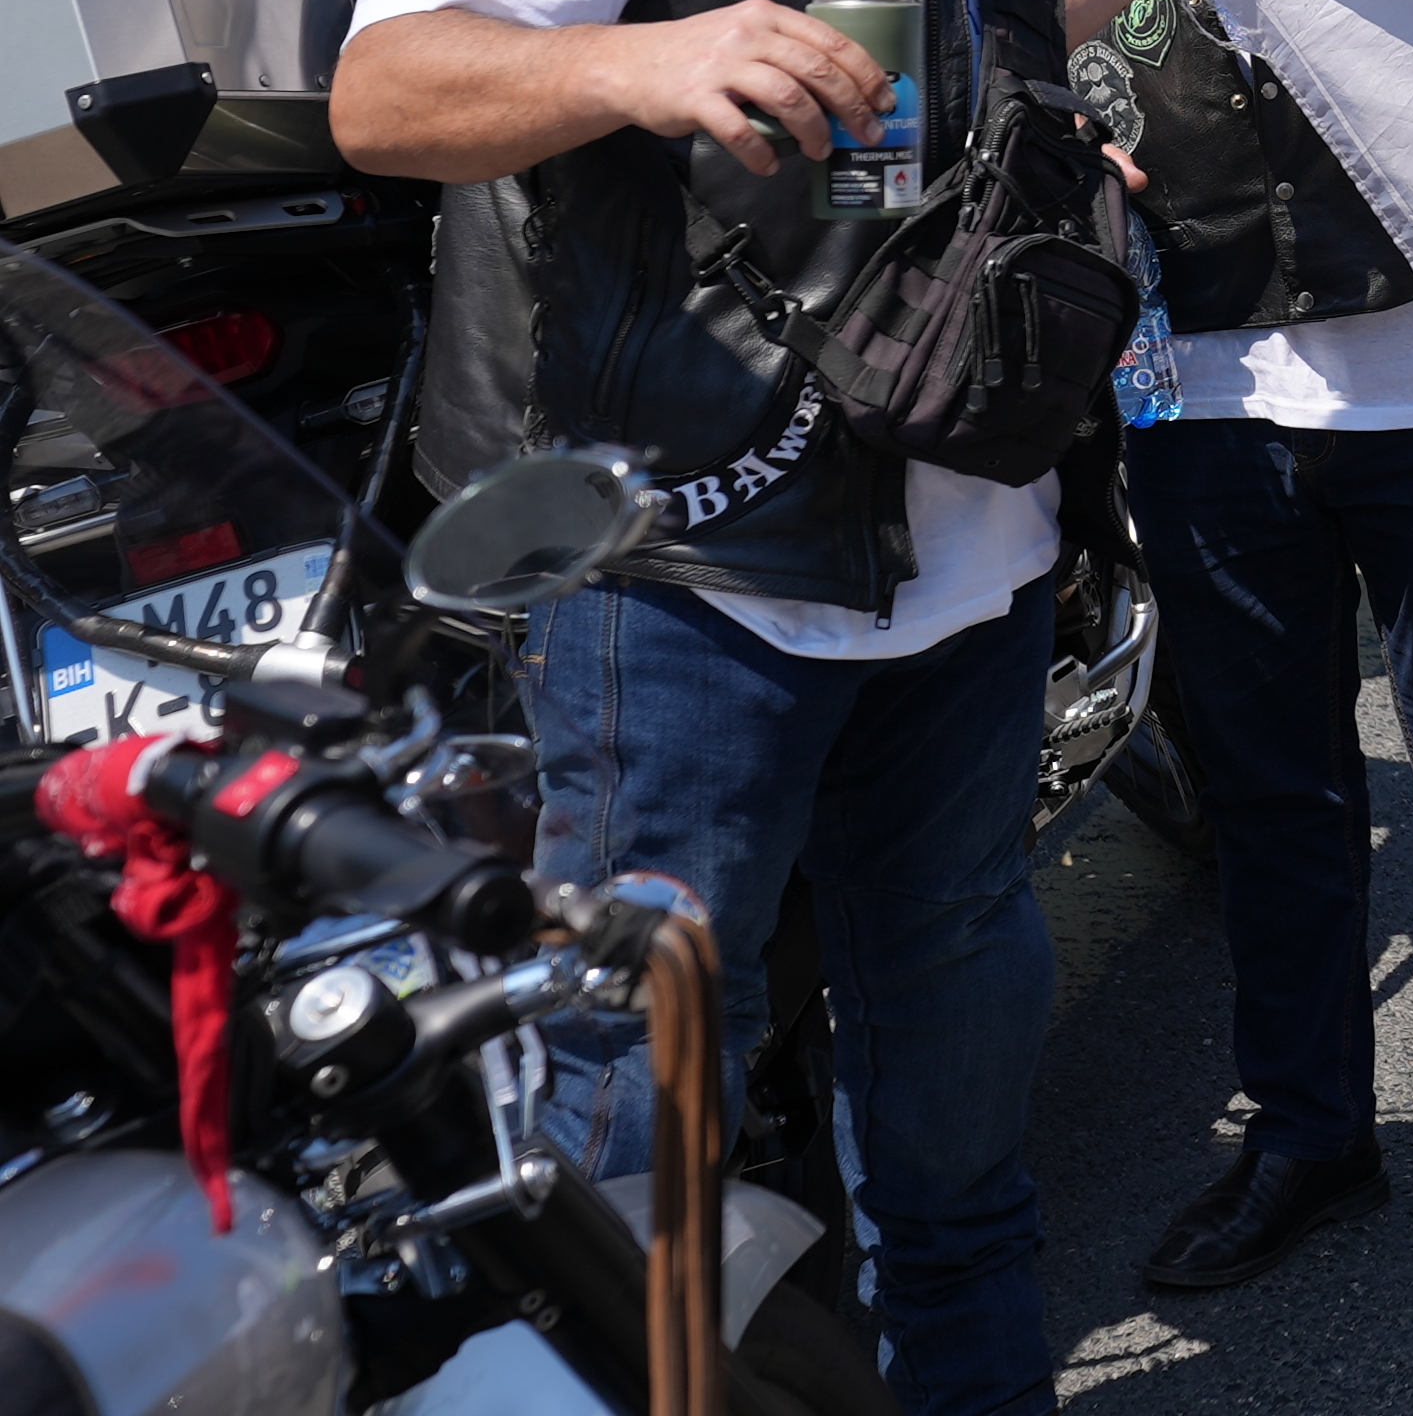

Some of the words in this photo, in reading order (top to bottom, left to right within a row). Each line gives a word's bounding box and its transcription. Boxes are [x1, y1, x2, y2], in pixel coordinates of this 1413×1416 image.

[850, 151, 894, 162] THERMAL
[141, 569, 283, 645] M48
[53, 660, 92, 691] BIH
